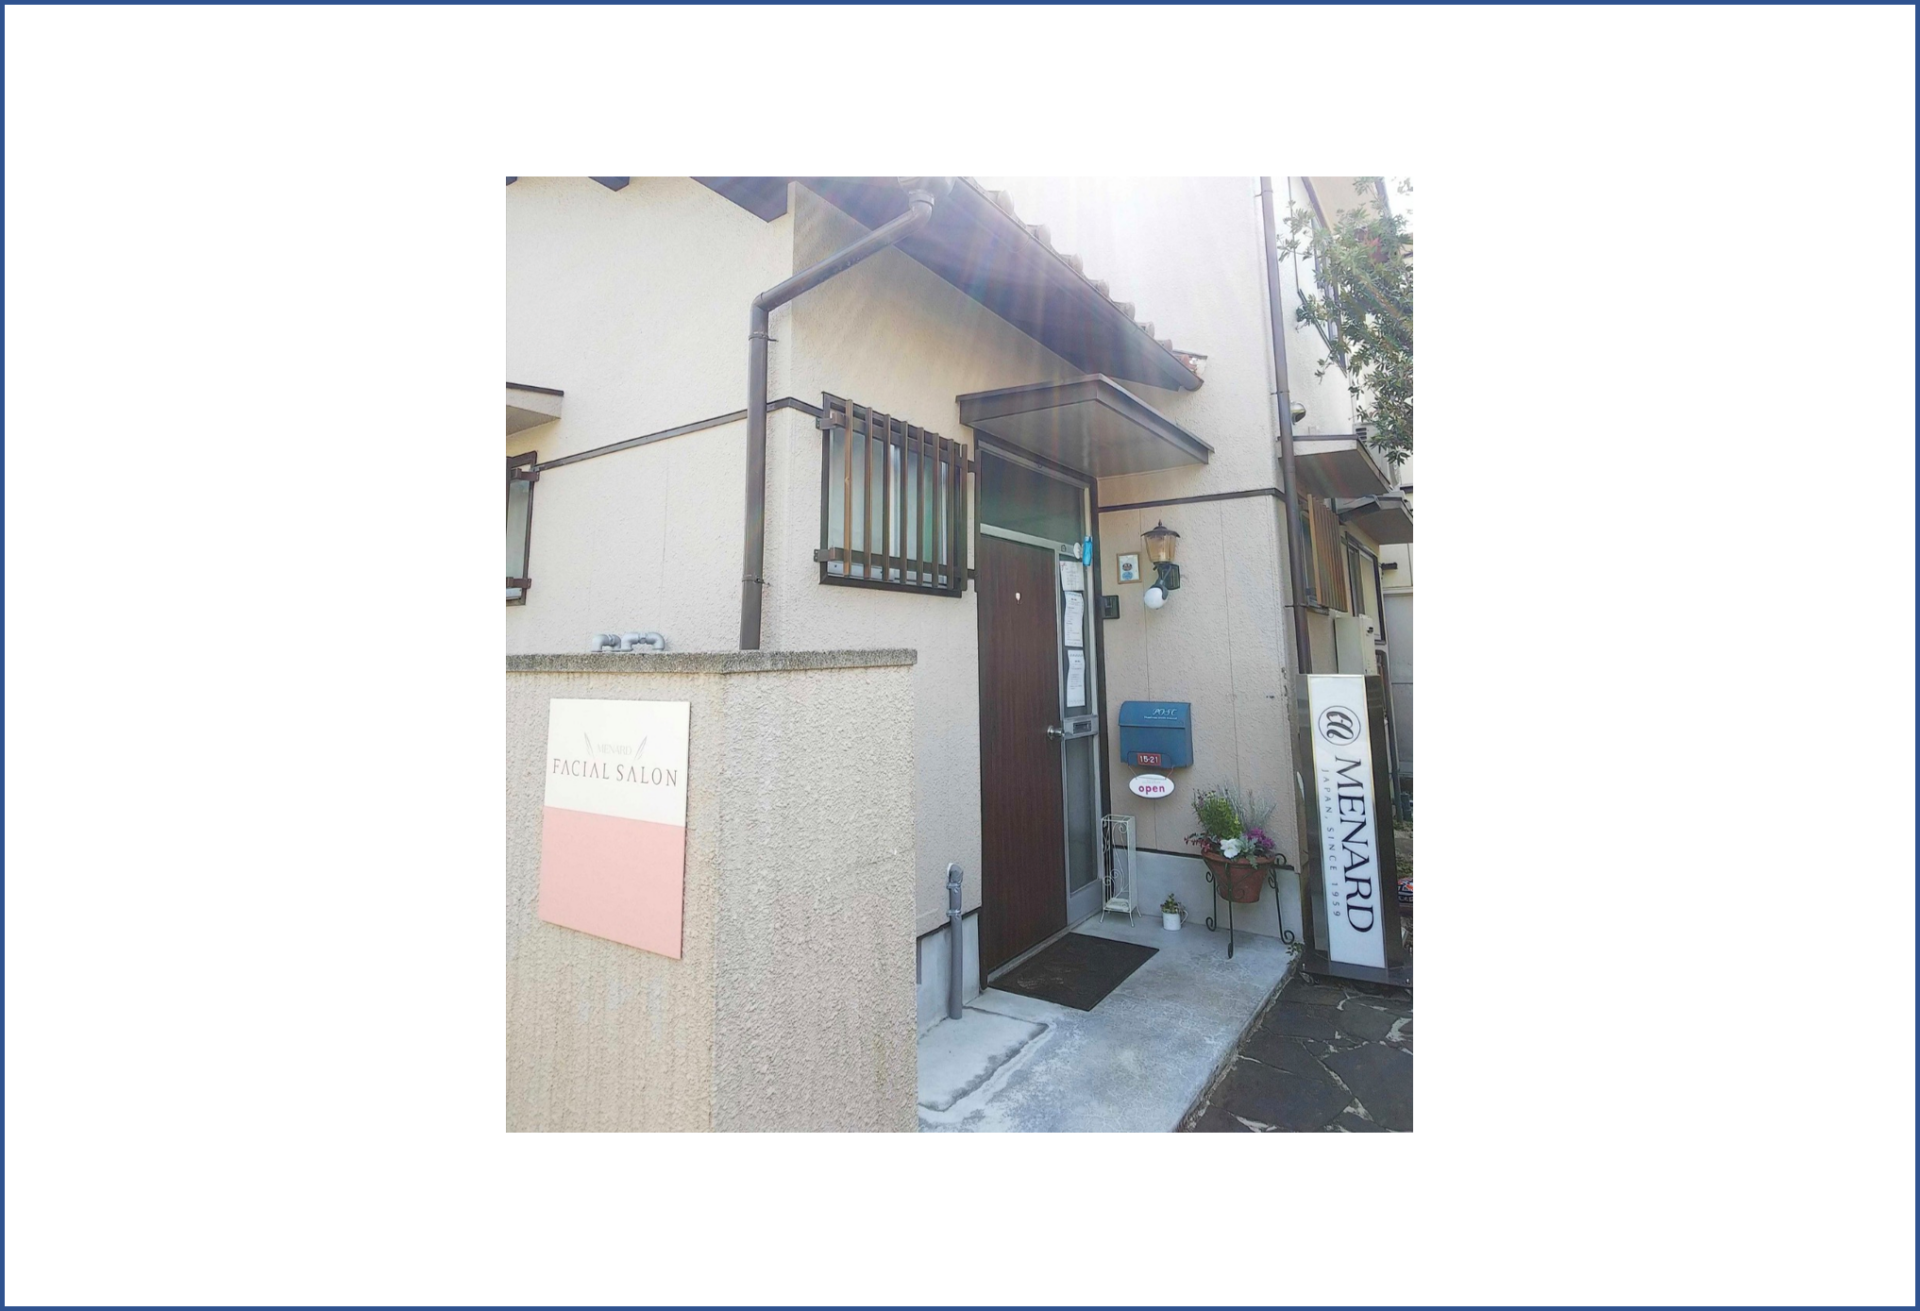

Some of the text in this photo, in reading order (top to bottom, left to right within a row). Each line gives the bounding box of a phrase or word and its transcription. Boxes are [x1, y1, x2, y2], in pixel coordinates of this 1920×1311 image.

[597, 743, 633, 756] MENARD
[552, 758, 678, 787] FACIAL SALON
[1138, 785, 1166, 795] open
[1321, 768, 1342, 917] JAPAN, SINCE 1959
[1335, 755, 1375, 933] MENARD
